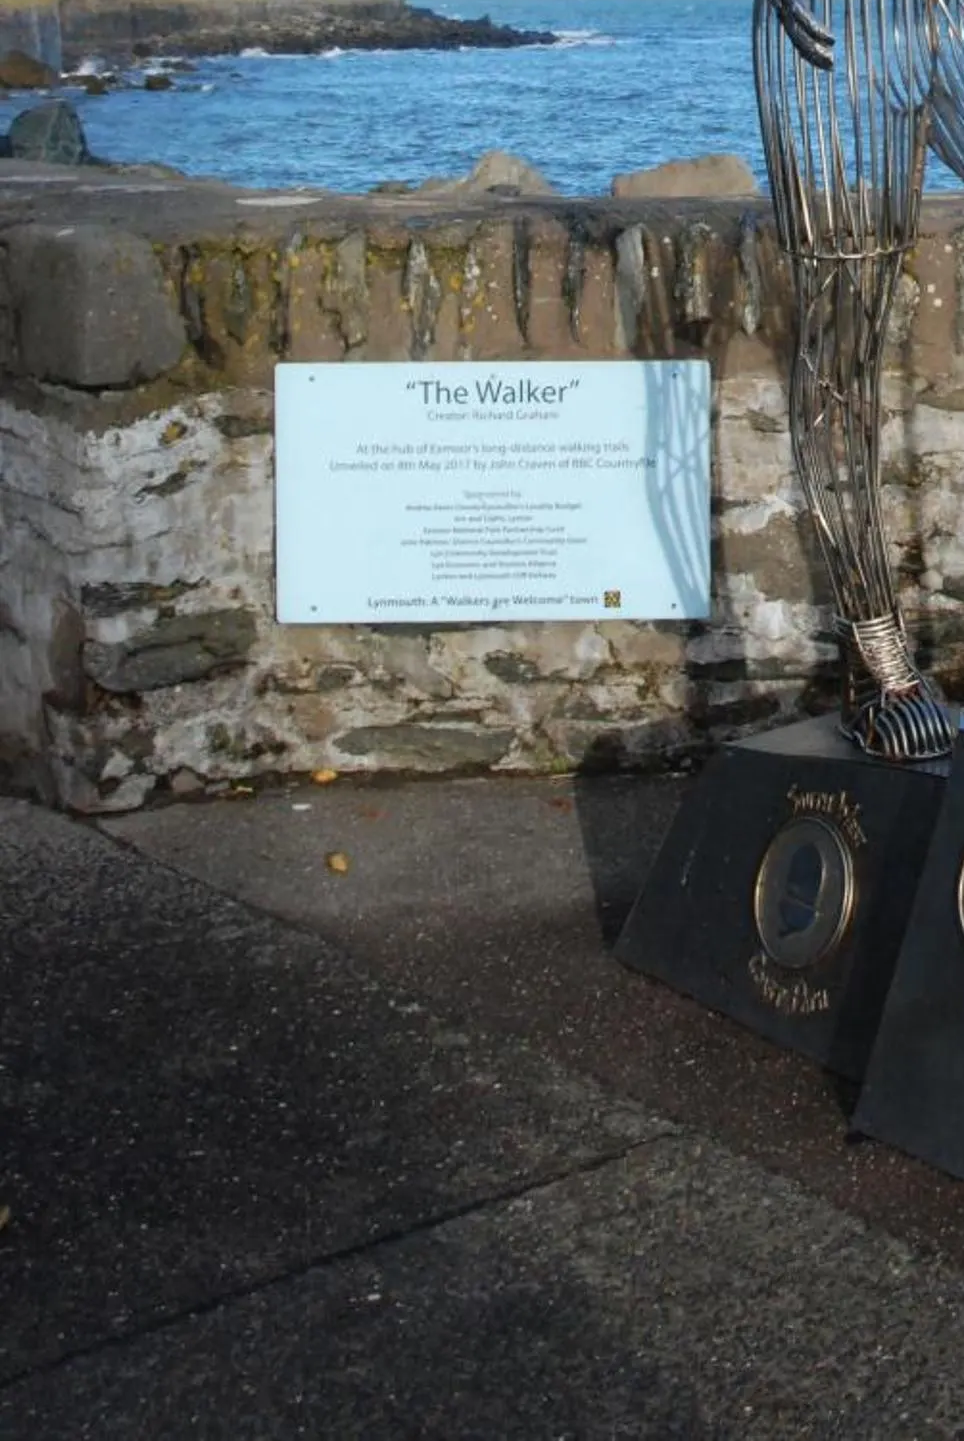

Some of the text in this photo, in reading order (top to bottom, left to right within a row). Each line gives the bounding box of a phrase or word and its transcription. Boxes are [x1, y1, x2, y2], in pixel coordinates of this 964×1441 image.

[473, 410, 514, 421] Richard
[356, 442, 368, 454] At
[371, 442, 388, 454] the
[391, 442, 414, 454] hub
[416, 442, 429, 454] of
[482, 442, 556, 456] long-distance
[559, 442, 601, 456] walking
[603, 442, 630, 454] trails
[380, 459, 394, 470] on
[417, 459, 441, 472] May
[444, 459, 470, 470] 2017
[473, 459, 486, 472] by
[489, 459, 516, 471] John
[518, 459, 556, 470] Craven
[558, 459, 569, 470] of
[571, 459, 594, 470] BBC
[430, 595, 439, 608] A
[491, 595, 509, 608] are
[569, 595, 599, 608] town
